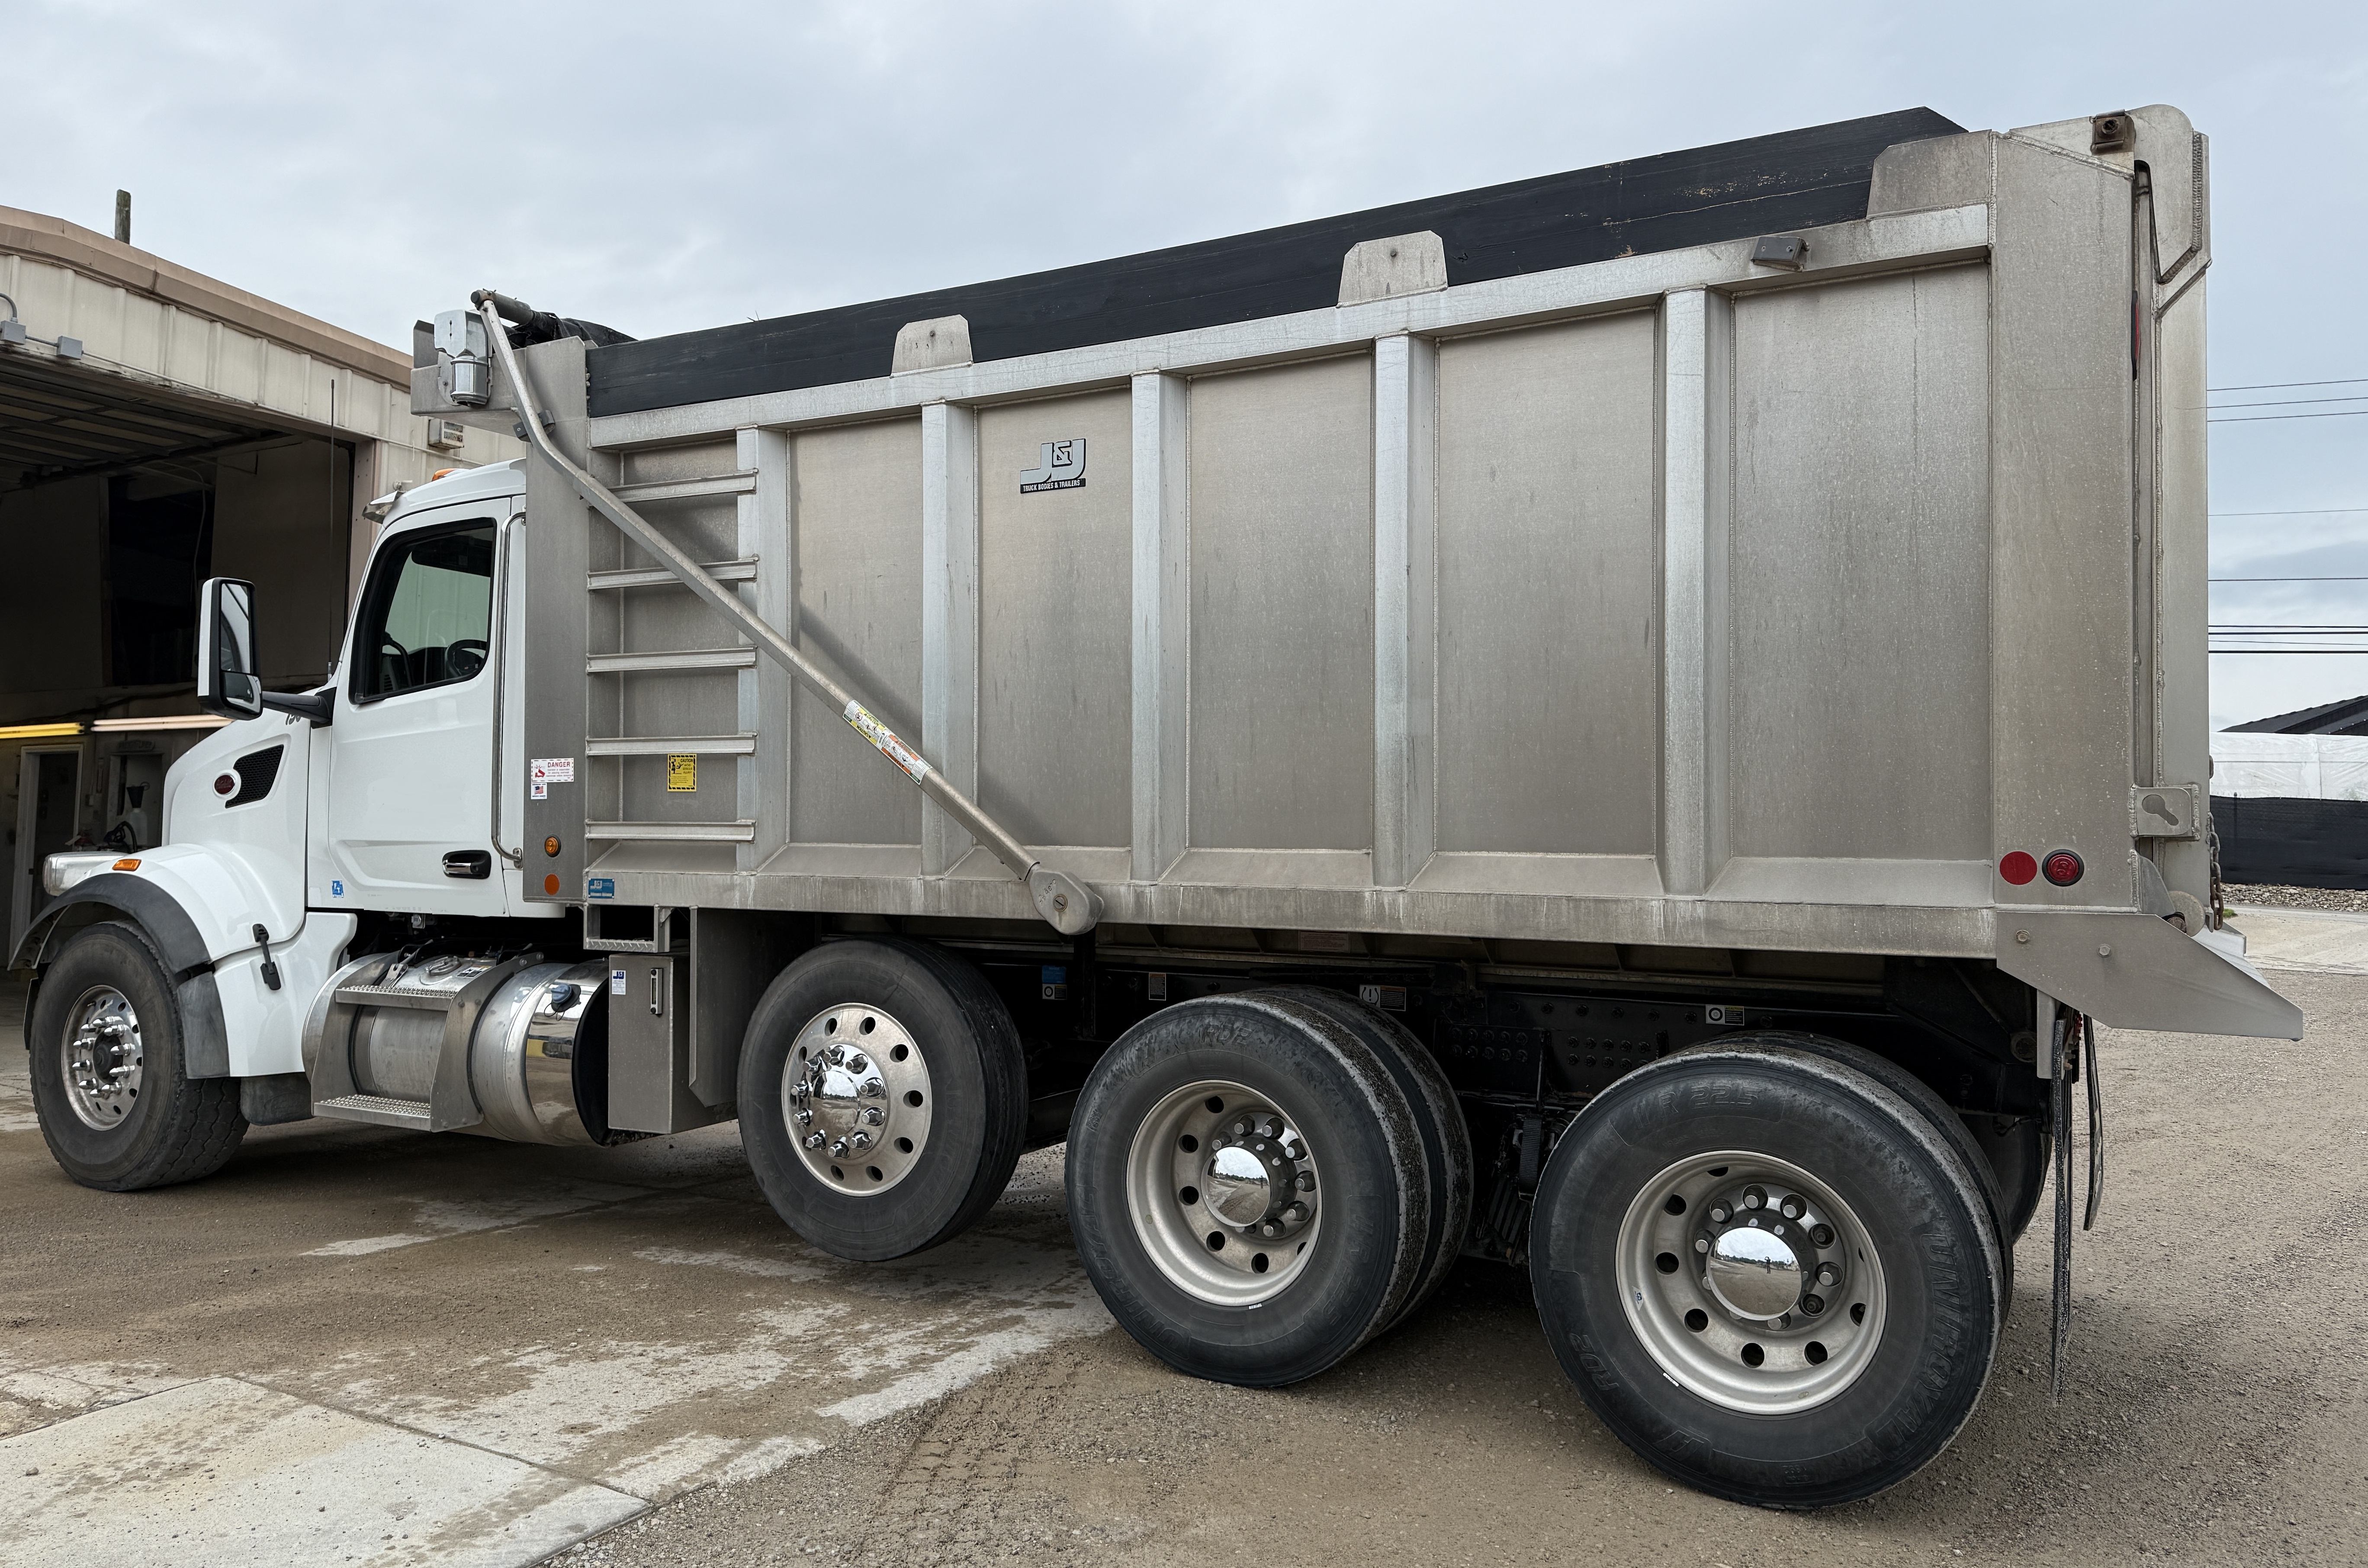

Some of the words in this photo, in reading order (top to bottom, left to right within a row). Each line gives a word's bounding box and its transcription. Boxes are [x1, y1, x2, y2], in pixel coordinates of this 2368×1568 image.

[1020, 438, 1086, 484] J&J
[1023, 484, 1037, 492] TRUCK
[1038, 482, 1054, 491] BODIES
[1199, 1023, 1253, 1047] RD2
[1690, 1085, 1762, 1109] 22.5
[1077, 1193, 1185, 1347] UNIROYAL
[1568, 1333, 1619, 1390] RD2
[1876, 1234, 1961, 1449] UNIROYAL
